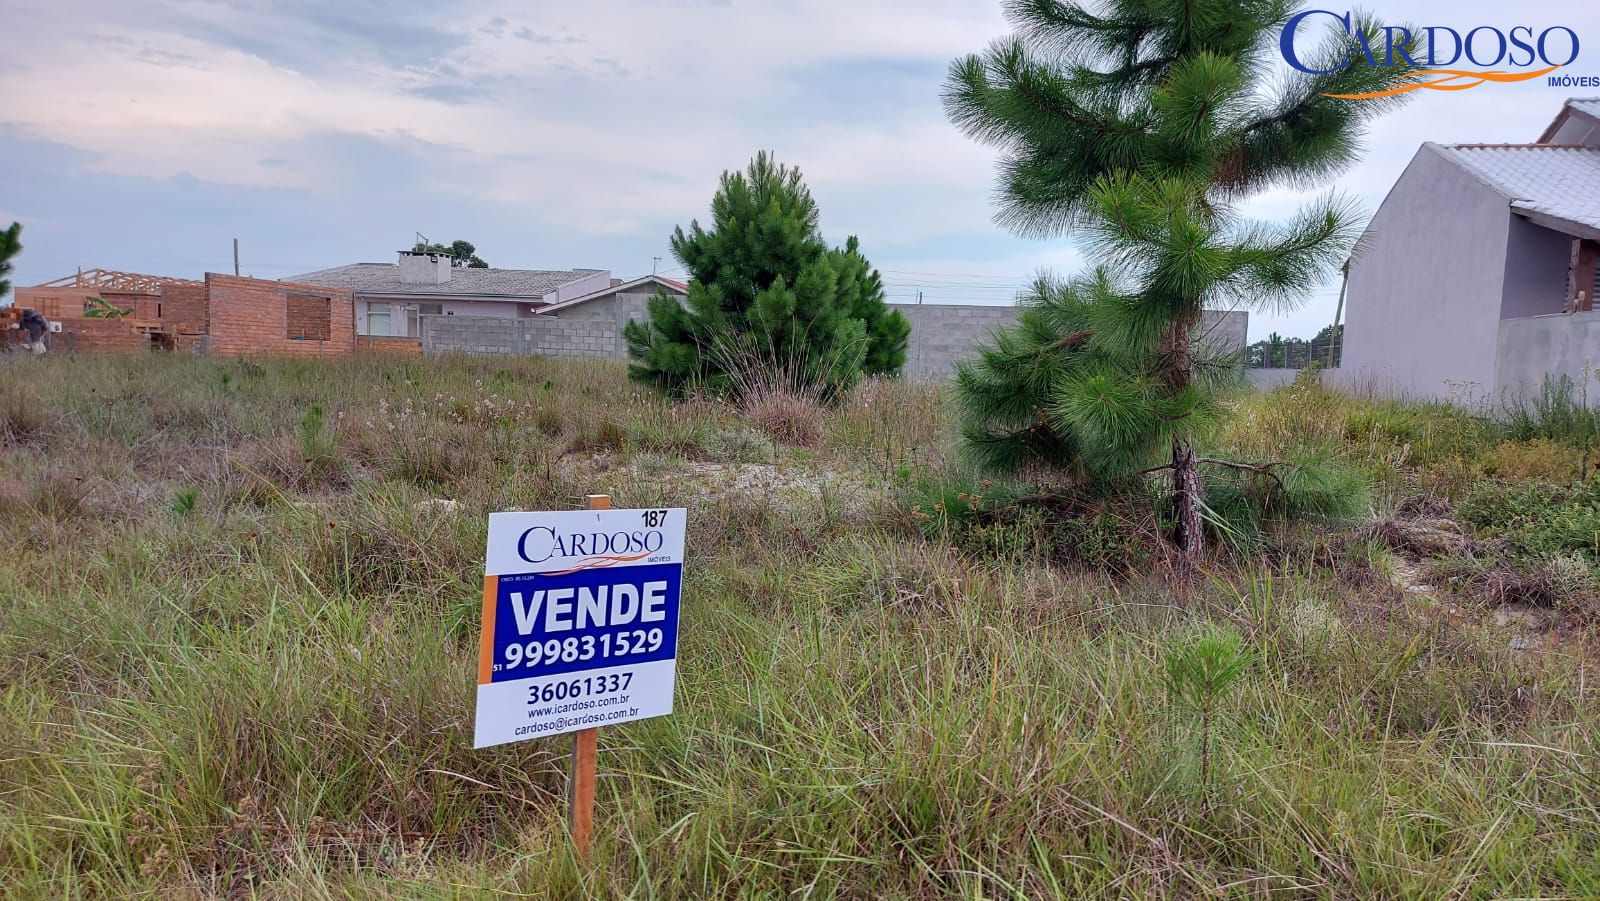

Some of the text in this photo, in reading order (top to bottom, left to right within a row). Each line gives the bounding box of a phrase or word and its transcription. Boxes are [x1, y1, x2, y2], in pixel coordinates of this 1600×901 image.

[641, 510, 668, 528] 187
[517, 526, 663, 563] CARDOSO
[510, 580, 668, 636] VENDE
[493, 628, 663, 672] 51 999831529
[527, 672, 633, 705] 36061337
[514, 706, 640, 736] cardoso@icardoso.com.br
[528, 693, 630, 719] www.icardoso.com.br
